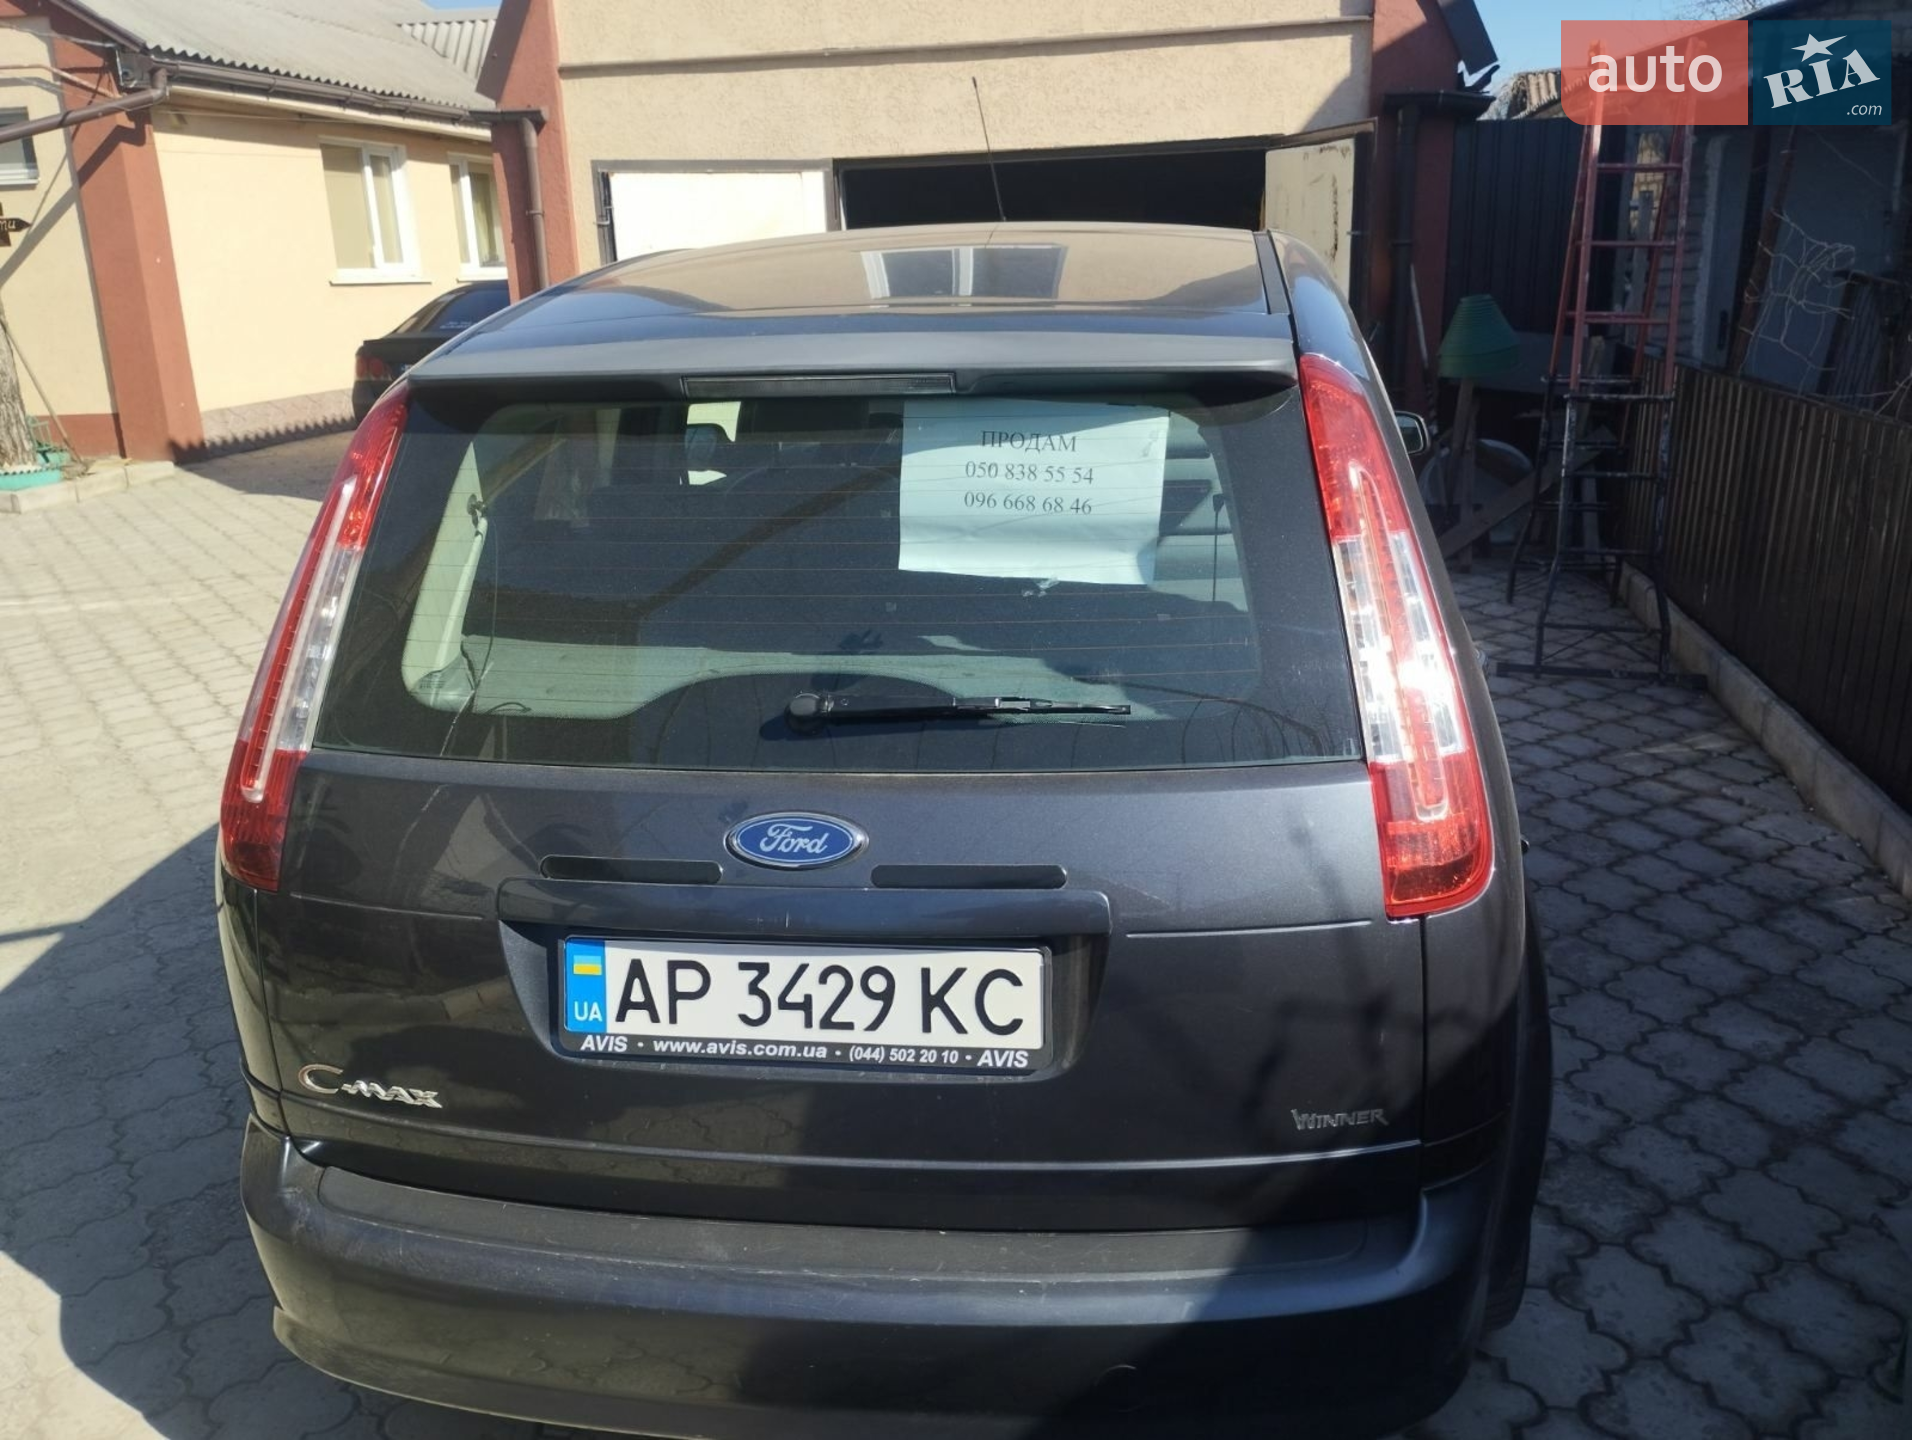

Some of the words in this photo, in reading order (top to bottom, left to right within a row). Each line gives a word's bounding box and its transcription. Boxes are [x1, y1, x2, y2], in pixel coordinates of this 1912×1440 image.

[982, 431, 1076, 453] ПРОДАМ
[965, 461, 998, 479] 050
[1004, 464, 1038, 482] 838
[1044, 466, 1065, 483] 55
[1072, 467, 1094, 485] 54
[964, 491, 997, 509] 096
[1003, 494, 1036, 512] 668
[1042, 497, 1064, 512] 68
[1070, 498, 1092, 515] 46
[759, 823, 829, 854] Ford
[615, 958, 711, 1025] AP
[738, 961, 896, 1031] 3429
[921, 967, 1024, 1036] KC
[574, 1001, 603, 1022] UA
[580, 1035, 628, 1053] AVIS
[653, 1039, 828, 1058] www.avis.com.ua
[849, 1045, 885, 1063] (044)
[889, 1048, 915, 1062] 502
[919, 1049, 937, 1063] 20
[941, 1050, 959, 1064] 10
[977, 1050, 1029, 1068] AVIS
[1290, 1109, 1389, 1130] WINNER
